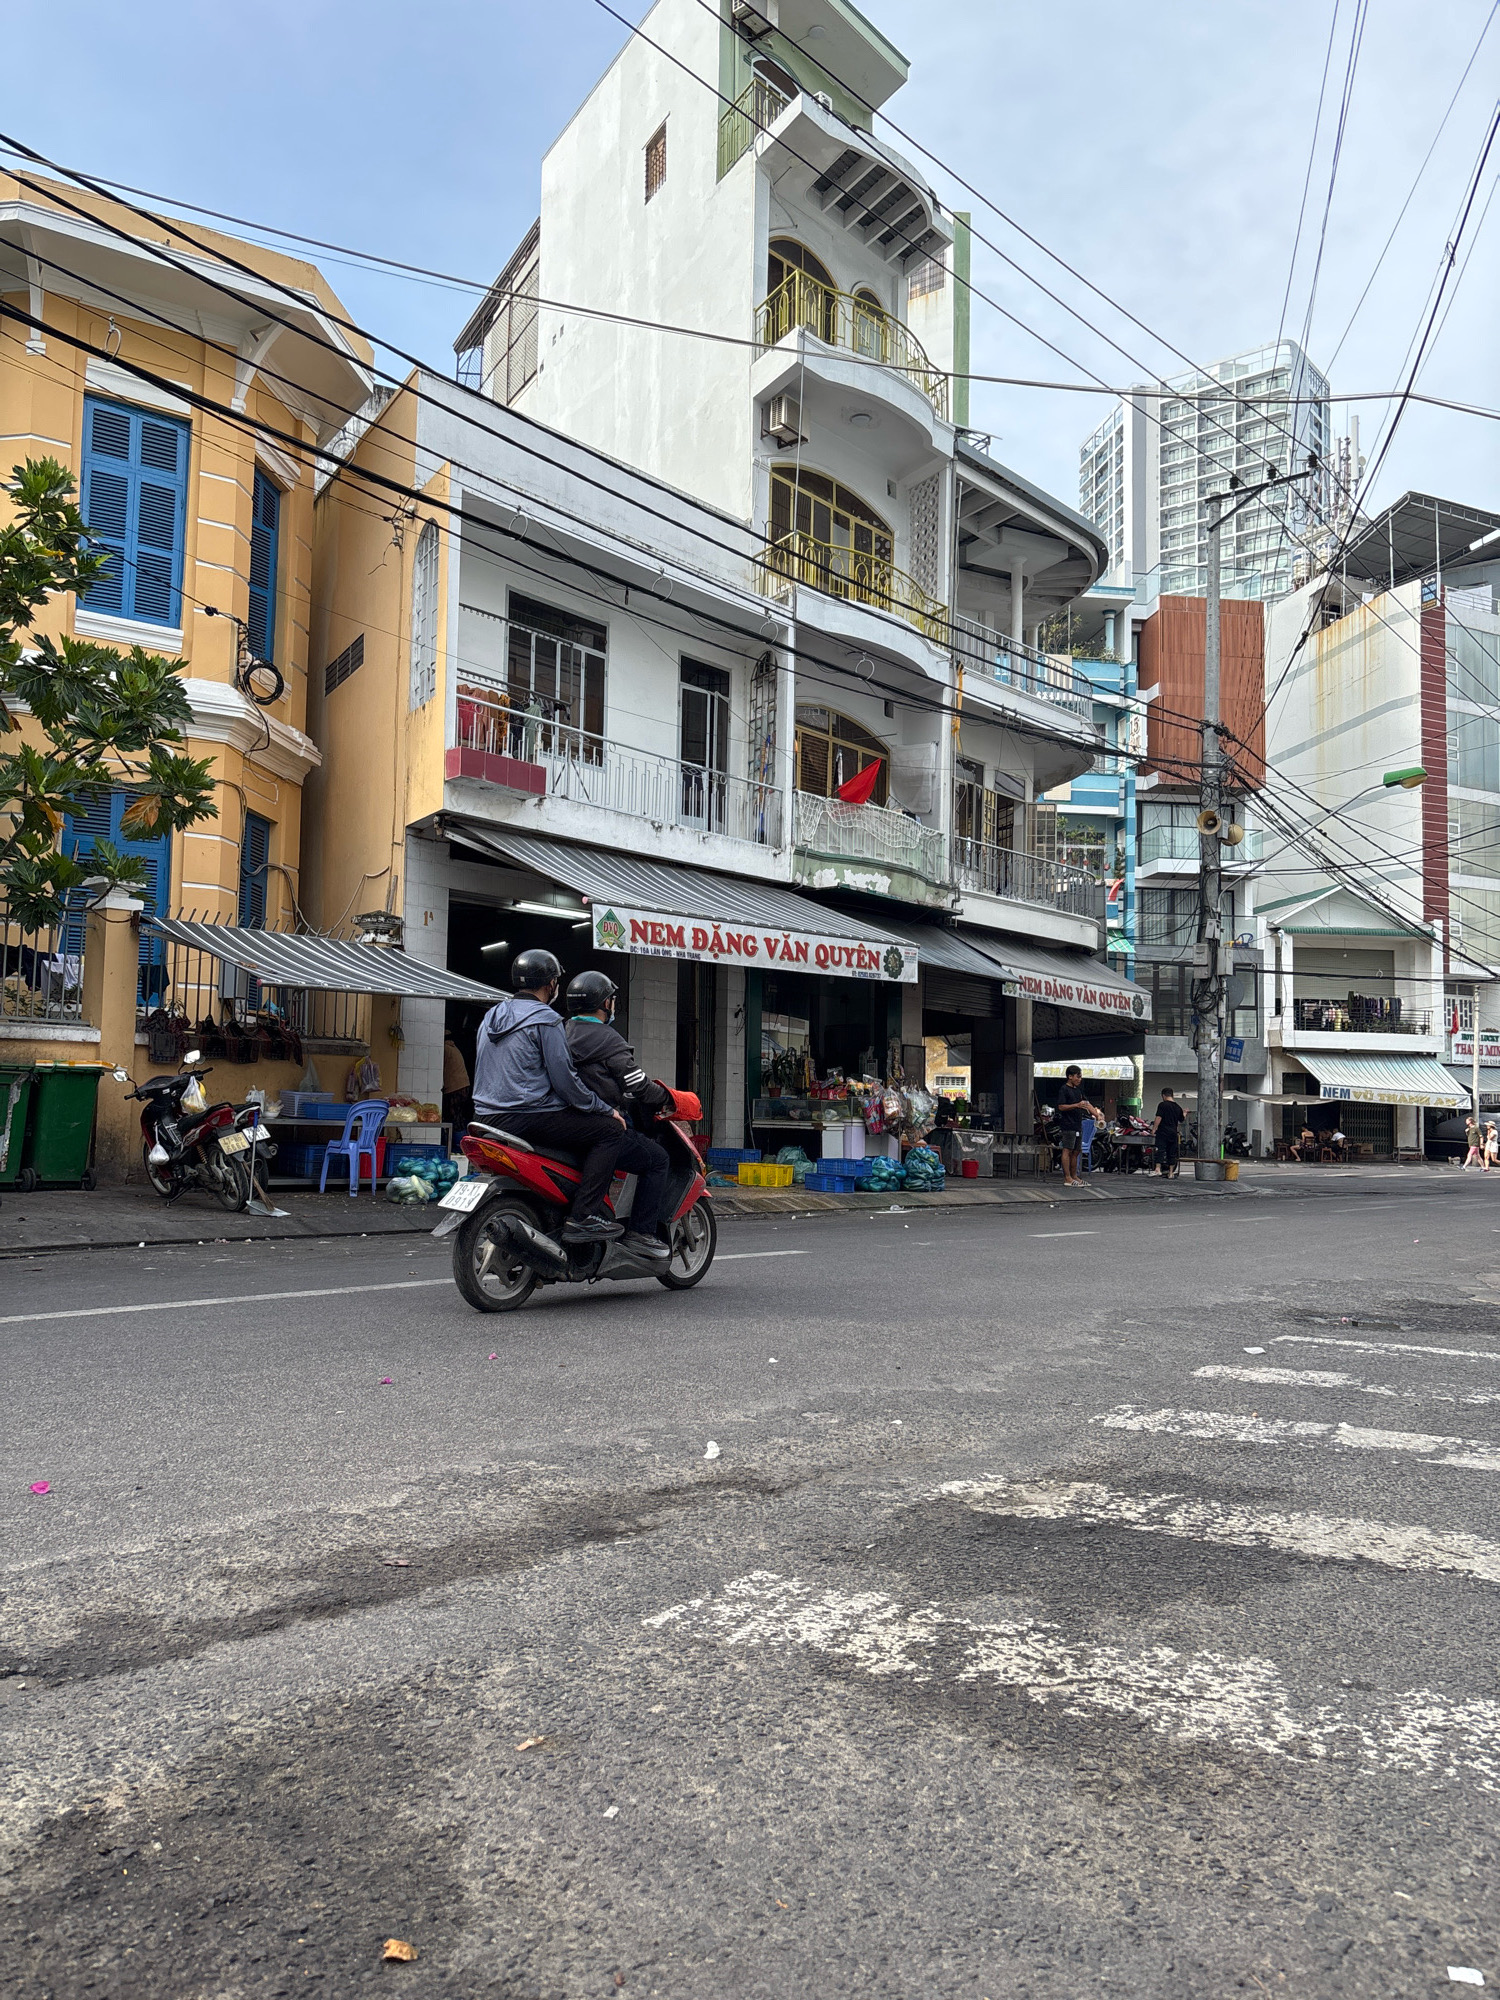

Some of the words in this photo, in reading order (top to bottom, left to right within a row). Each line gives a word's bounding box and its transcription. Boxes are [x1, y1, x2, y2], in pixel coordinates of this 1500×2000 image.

[630, 918, 686, 949] NEM
[692, 922, 759, 960] ĐẶNG
[763, 932, 811, 964] VĂN
[815, 942, 881, 971] QUYÊN
[686, 951, 702, 960] TRANG
[1018, 975, 1042, 995] NEM
[1044, 978, 1074, 1002] ĐẶNG
[1075, 984, 1097, 1005] VĂN
[1099, 991, 1131, 1011] QUYÊN
[1481, 1034, 1499, 1042] LUCKY
[1455, 1043, 1483, 1056] THAH
[1322, 1086, 1351, 1099] NEM
